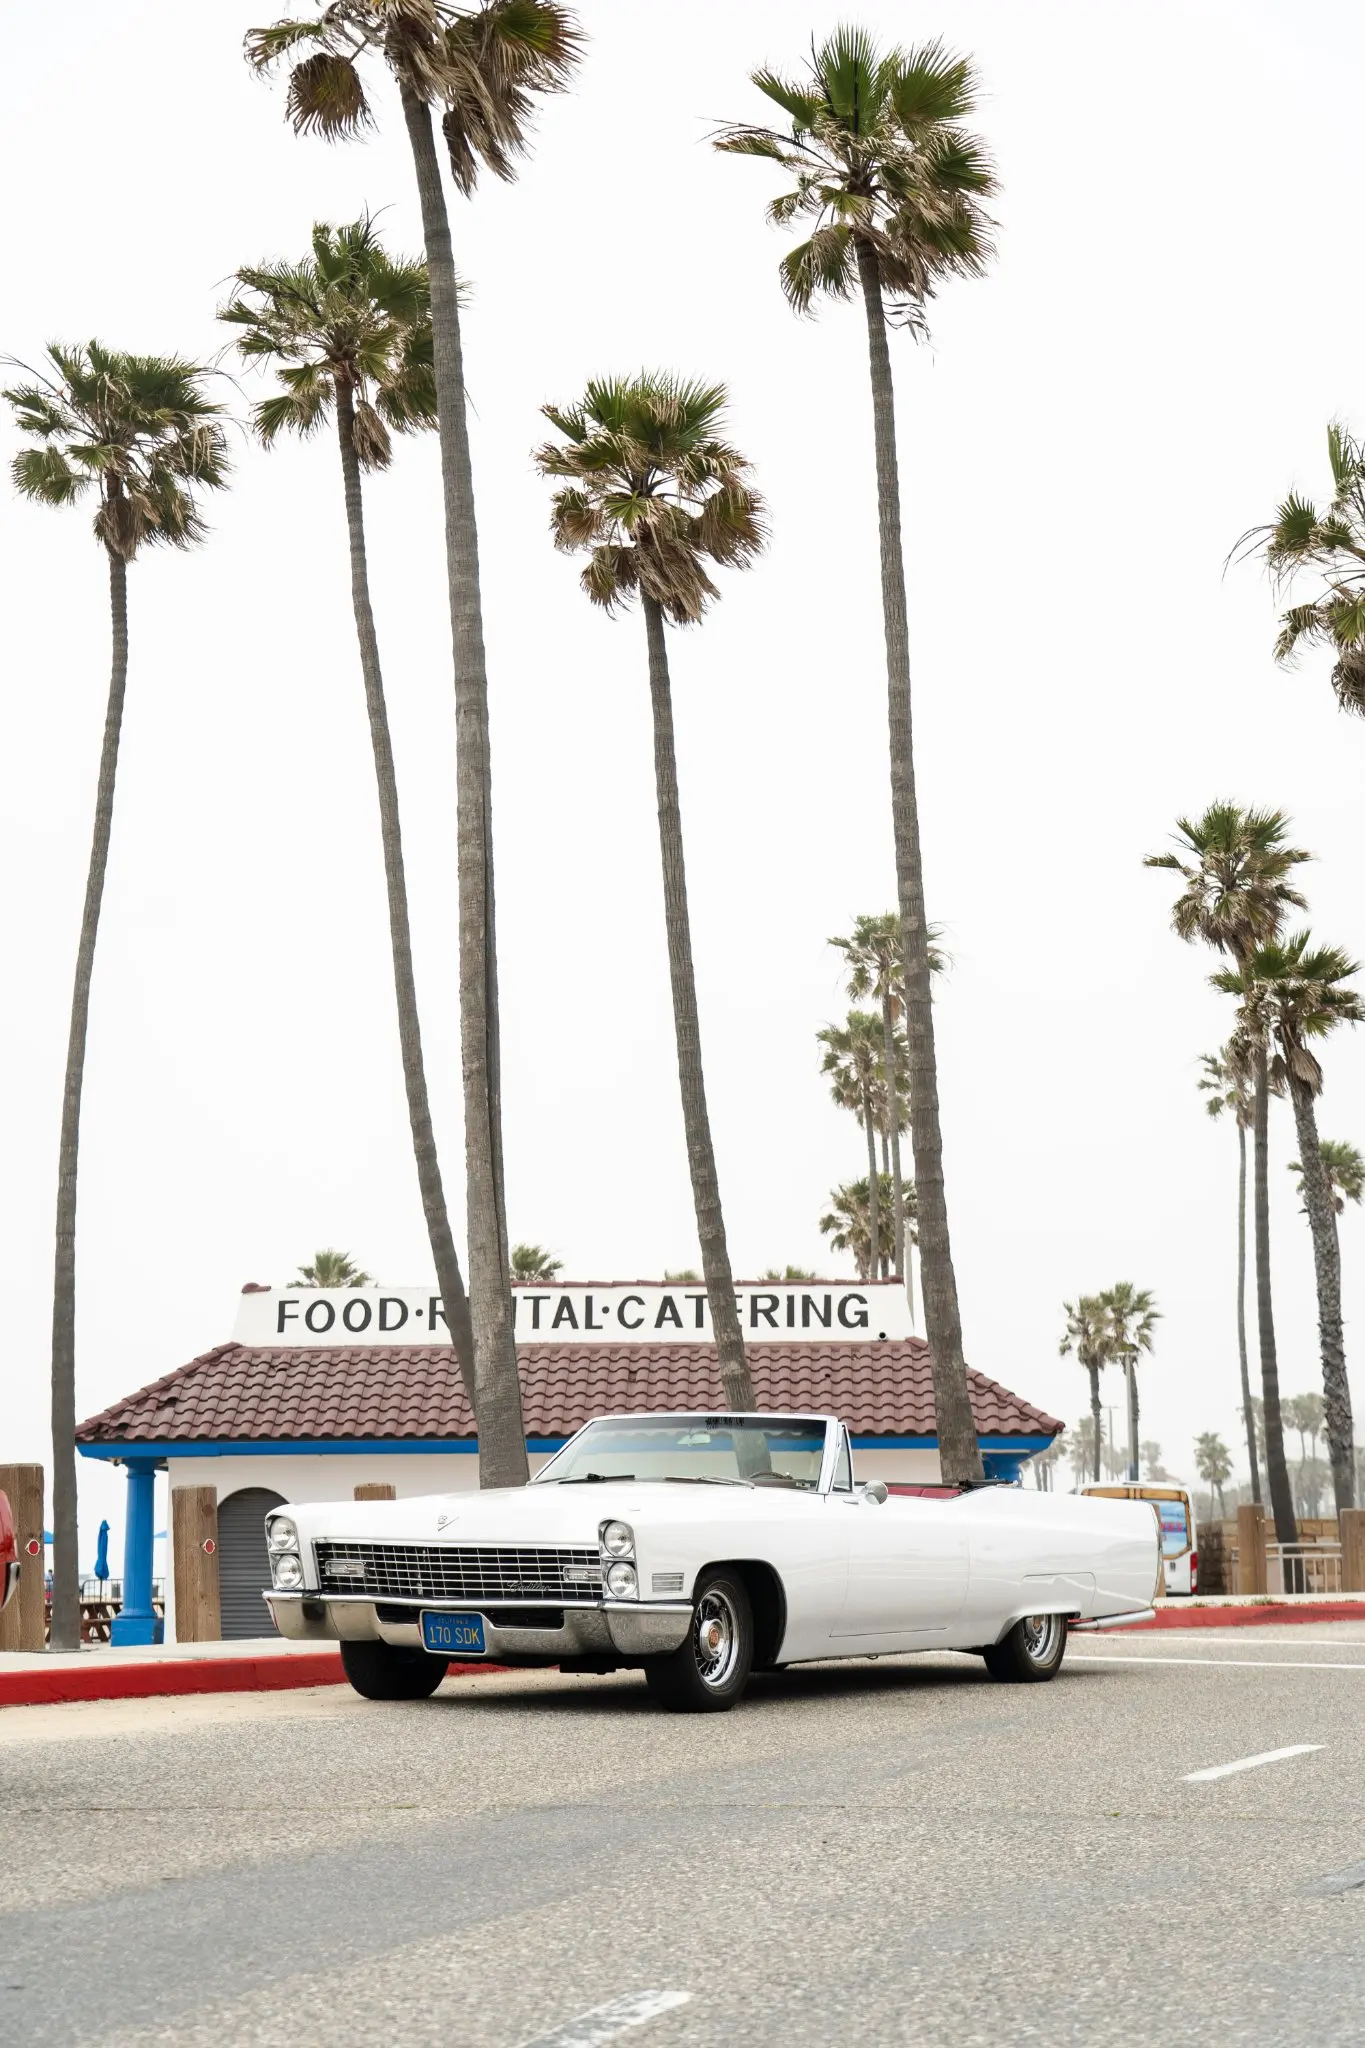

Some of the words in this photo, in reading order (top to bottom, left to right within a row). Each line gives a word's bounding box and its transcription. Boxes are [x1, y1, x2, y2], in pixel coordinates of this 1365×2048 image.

[617, 1293, 869, 1329] CATRING
[429, 1626, 451, 1644] 170
[455, 1627, 481, 1645] SDK
